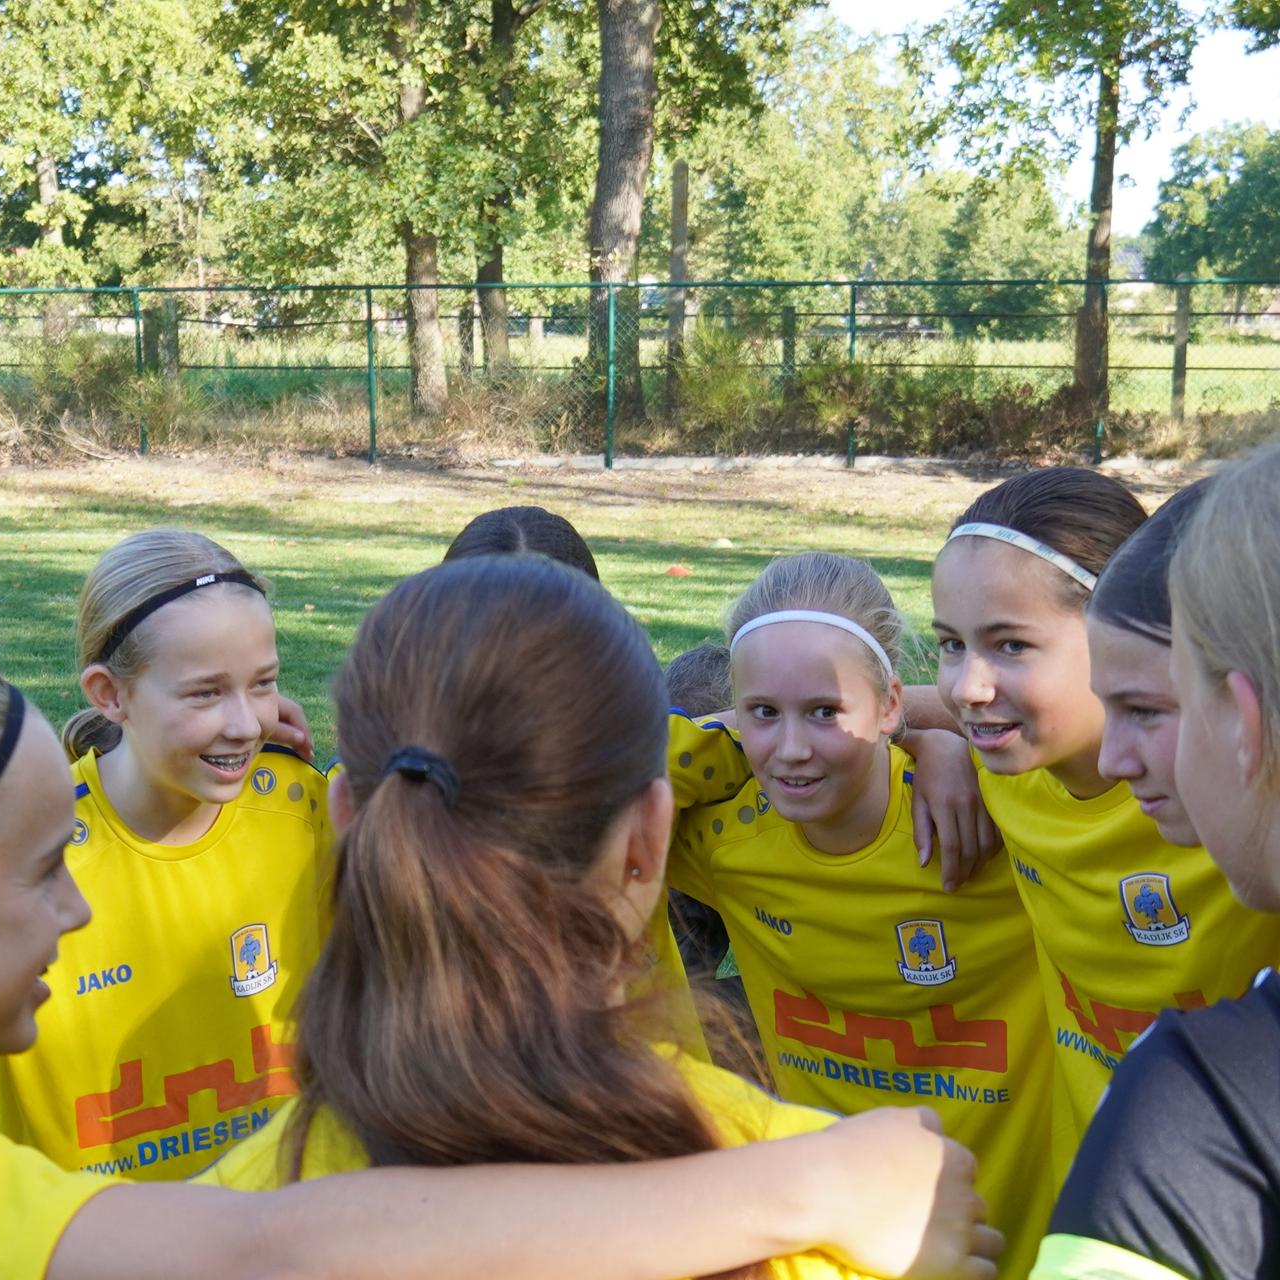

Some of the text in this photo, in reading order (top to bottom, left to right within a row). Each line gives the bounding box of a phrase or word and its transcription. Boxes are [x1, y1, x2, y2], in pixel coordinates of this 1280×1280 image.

[754, 905, 793, 936] JAKO
[1173, 926, 1185, 938] SK
[76, 964, 133, 996] JAKO
[905, 969, 952, 982] KADIJK SK
